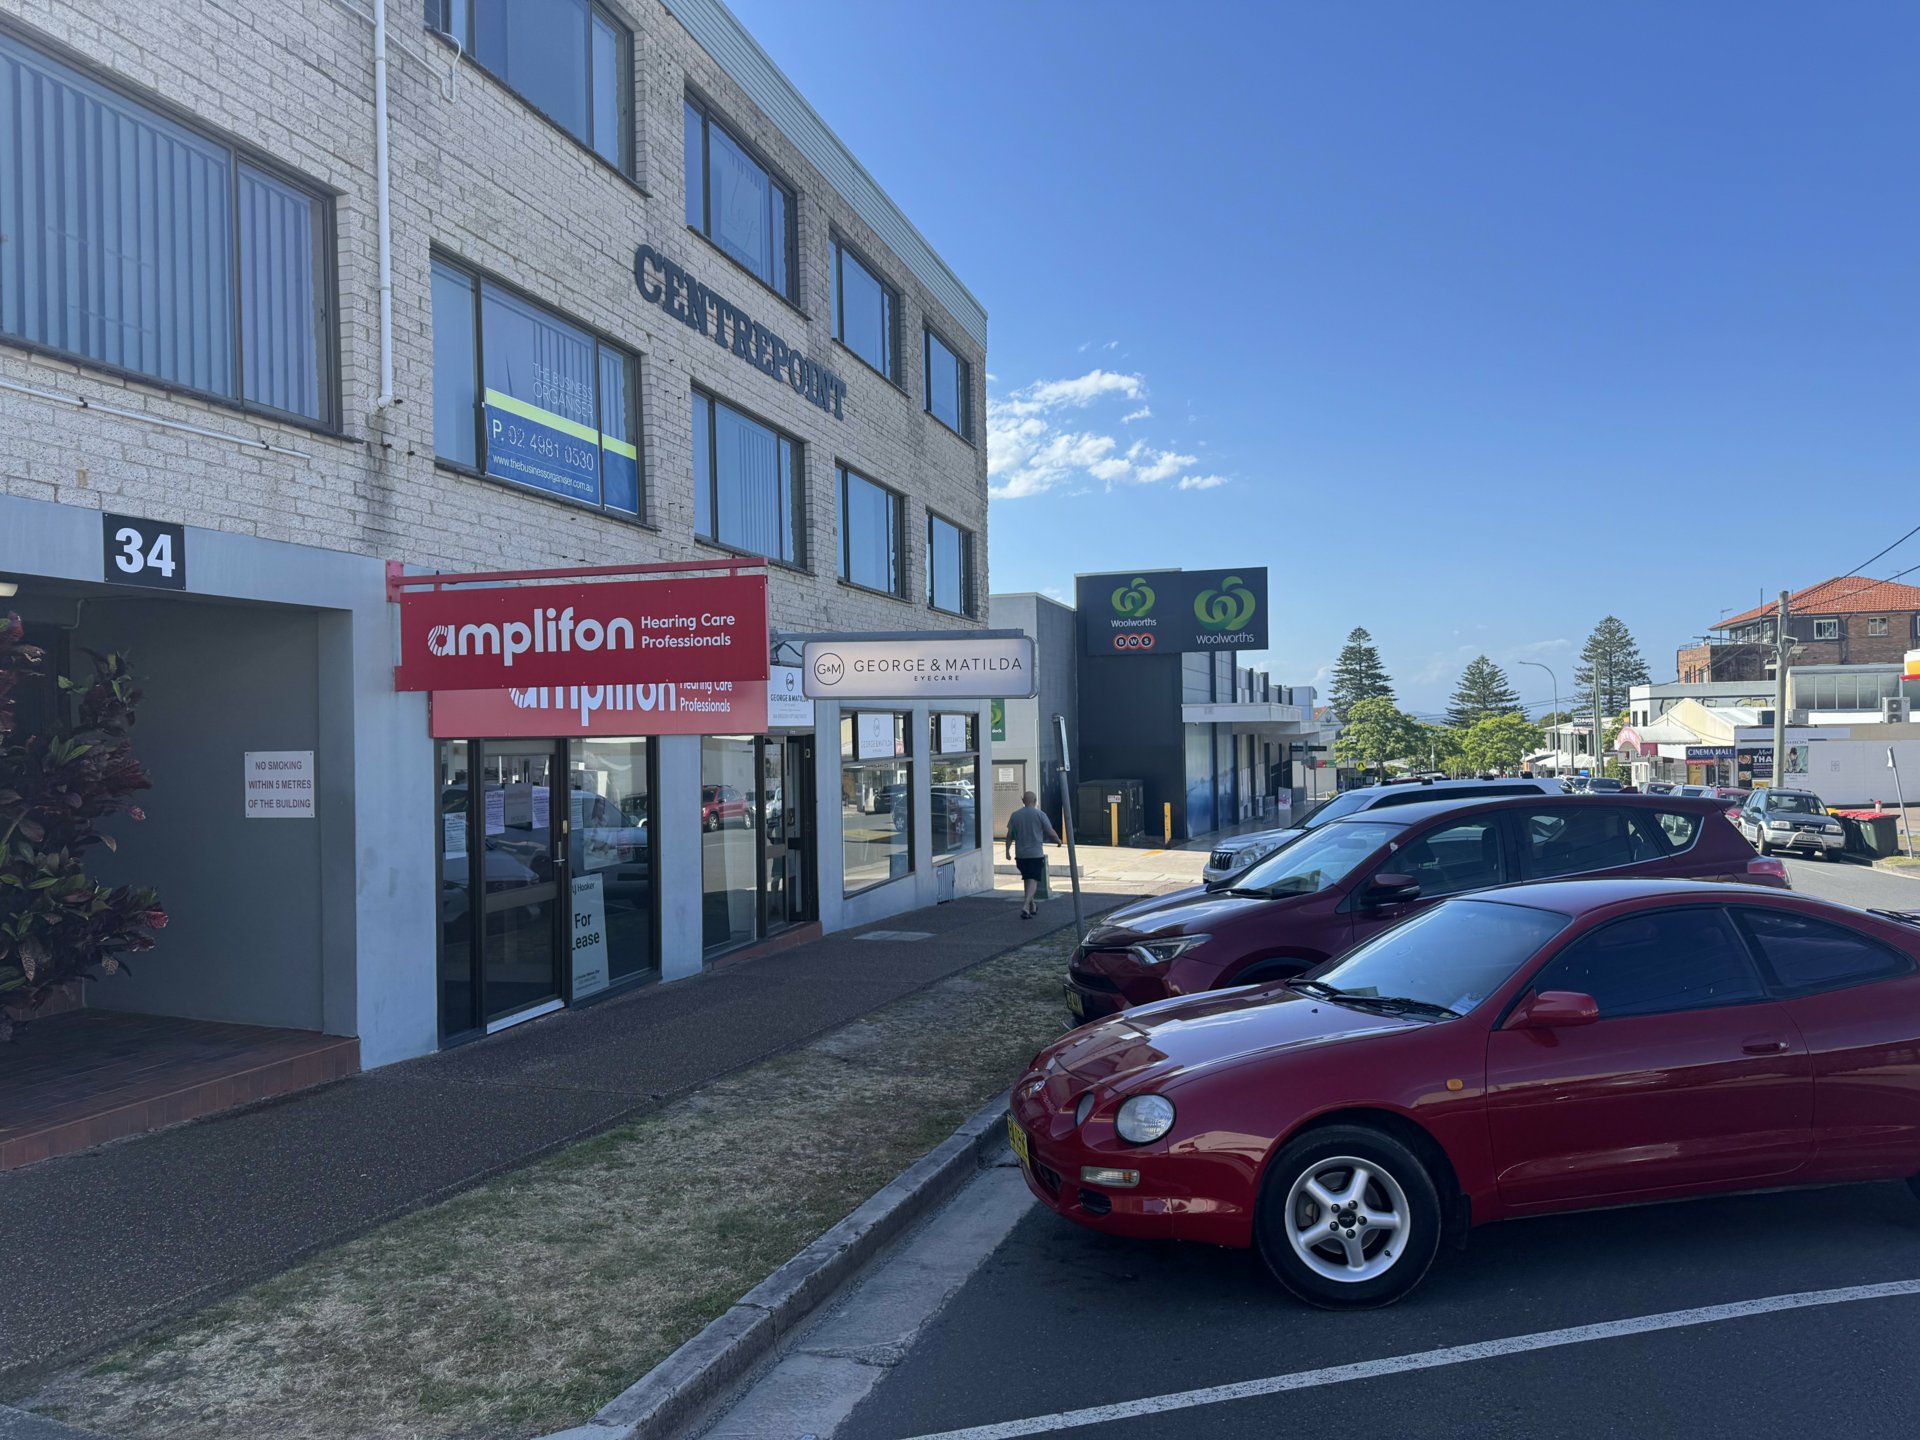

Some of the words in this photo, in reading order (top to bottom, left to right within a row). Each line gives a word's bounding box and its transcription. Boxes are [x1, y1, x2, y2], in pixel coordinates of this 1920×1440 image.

[634, 244, 847, 421] CENTREPOINT
[532, 362, 550, 382] THE
[552, 371, 592, 400] BUSINESS
[533, 381, 593, 419] ORGANISER
[492, 418, 504, 442] P.
[529, 433, 559, 459] 4981
[564, 444, 594, 471] 0530
[114, 527, 176, 578] 34
[1110, 617, 1157, 628] Woolworths
[427, 606, 635, 667] amplifon
[640, 615, 697, 631] Hearing
[700, 613, 736, 627] Care
[641, 632, 732, 649] Professionals
[1195, 631, 1255, 645] Woolworths
[853, 658, 926, 673] GEORGE
[931, 659, 942, 672] &
[945, 657, 1023, 671] MATILDA
[680, 697, 731, 713] Professionals
[770, 693, 788, 702] GEORGE
[1687, 748, 1714, 756] CINEMA
[255, 760, 267, 770] NO
[267, 760, 303, 770] SMOKING
[248, 780, 274, 790] WITHIN
[275, 780, 281, 790] 5
[281, 779, 312, 789] METRES
[248, 799, 258, 809] OF
[260, 799, 274, 809] THE
[275, 798, 311, 809] BUILDING
[577, 882, 596, 892] Hooker
[574, 912, 592, 930] For
